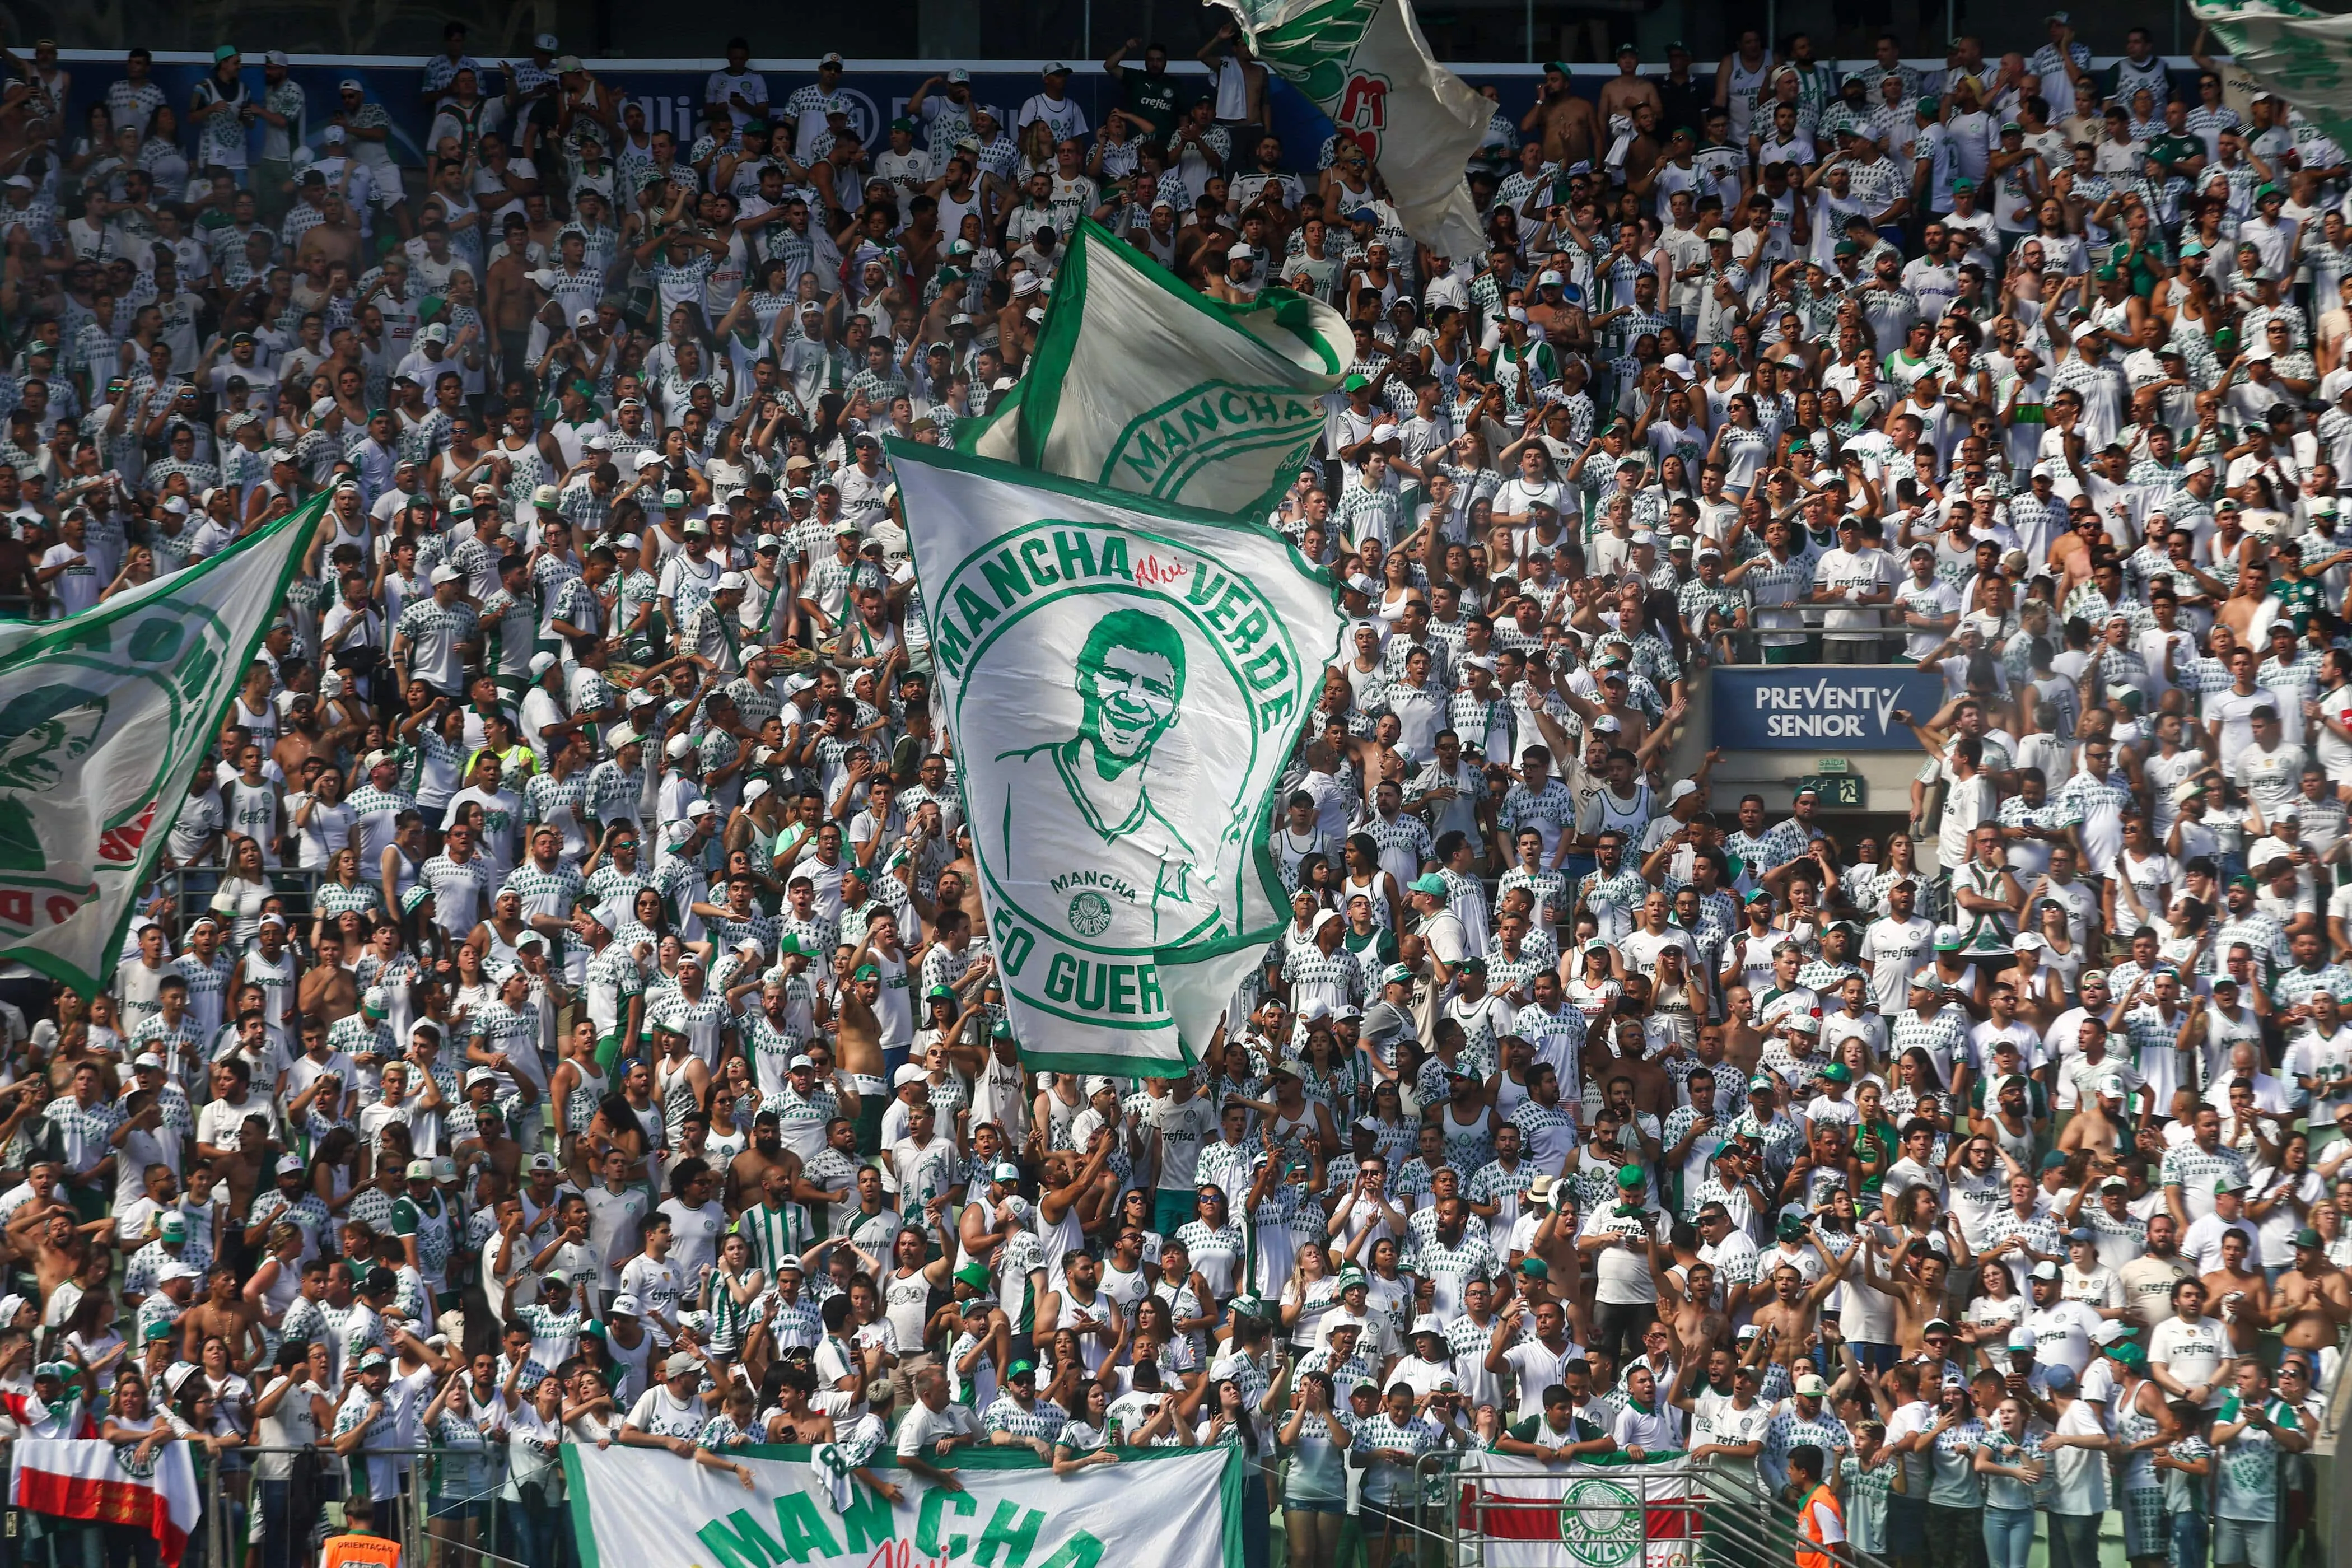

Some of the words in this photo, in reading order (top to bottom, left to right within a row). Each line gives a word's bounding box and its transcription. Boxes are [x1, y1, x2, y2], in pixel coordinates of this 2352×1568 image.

[1140, 97, 1172, 111] crefisa
[712, 271, 743, 283] PIRELLI
[1920, 287, 1955, 297] parmalat
[1123, 390, 1315, 483] MANCHA
[1835, 576, 1872, 590] crefisa
[936, 530, 1134, 679] MANCHA
[1184, 562, 1294, 734] VERDE
[1756, 678, 1876, 710] PREVENT
[1818, 758, 1846, 767] SAÍDA
[1050, 871, 1136, 903] MANCHA
[1072, 906, 1110, 936] PALMEIRAS
[1942, 932, 1949, 944] P
[1883, 946, 1919, 960] crefisa
[1044, 951, 1168, 1014] GUER
[1963, 1191, 1999, 1205] crefisa
[1606, 1224, 1648, 1237] crefisa
[1303, 1299, 1333, 1310] refisa
[2172, 1341, 2215, 1356] crefisa
[1112, 1402, 1136, 1416] MANCHA
[338, 1541, 394, 1553] ORIENTAÇÃO
